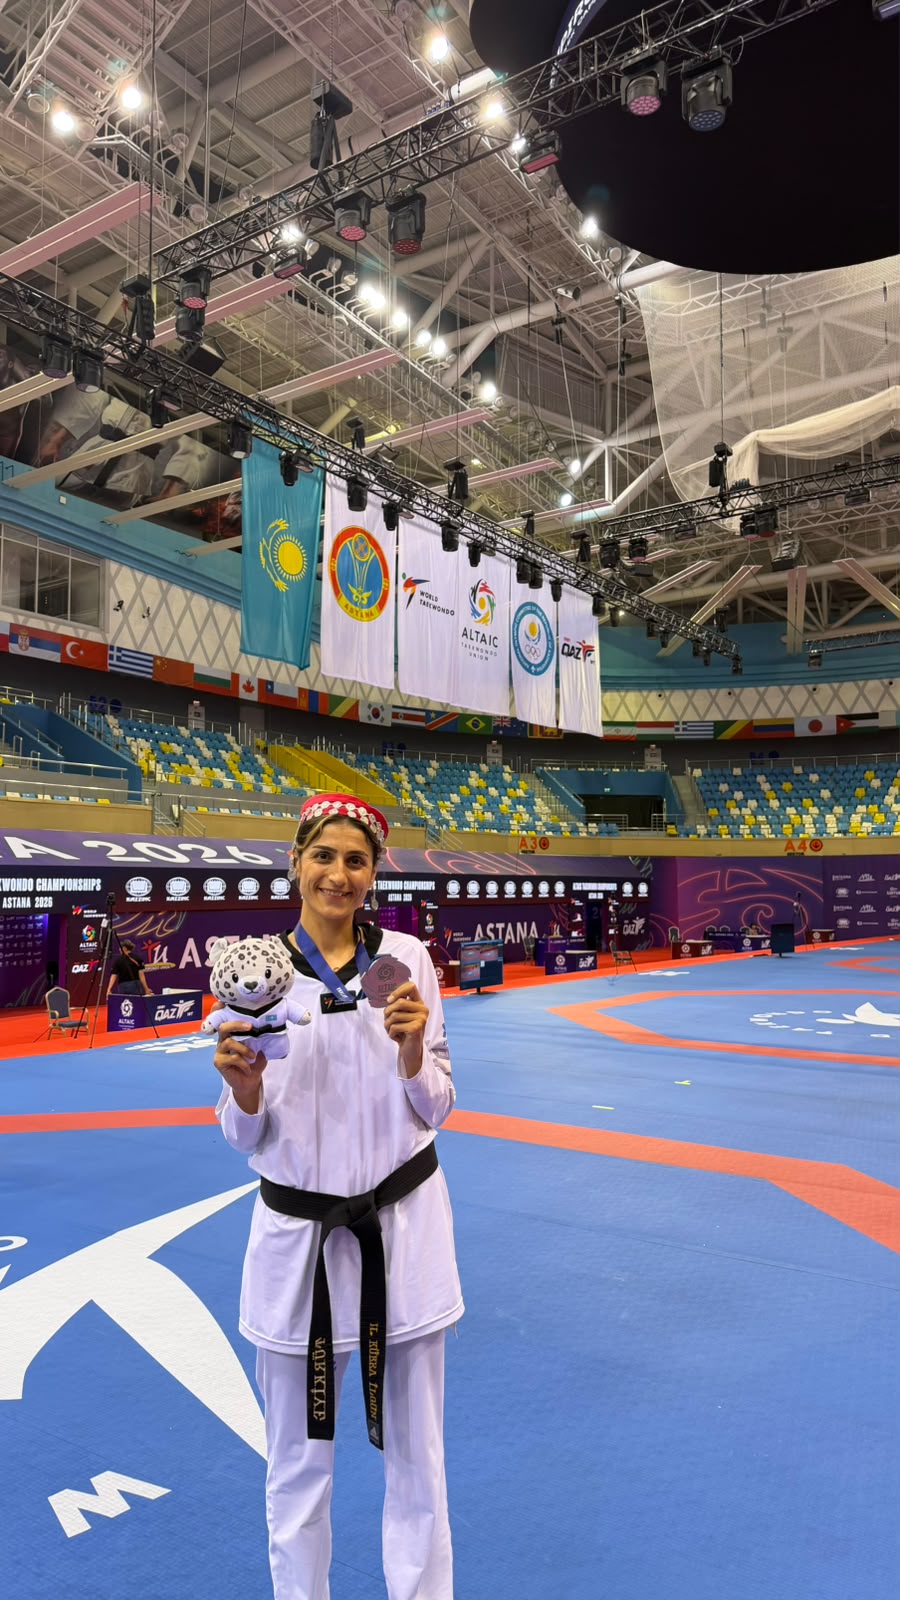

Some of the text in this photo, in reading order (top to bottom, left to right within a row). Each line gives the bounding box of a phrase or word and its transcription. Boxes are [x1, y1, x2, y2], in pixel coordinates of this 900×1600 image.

[419, 590, 439, 603] WORLD
[419, 599, 455, 616] TAEKWONDO
[461, 626, 498, 649] ALTAIC
[461, 641, 498, 657] TAEKWONDO
[469, 651, 489, 661] UNION
[519, 836, 538, 850] A3
[784, 839, 808, 852] A4
[82, 840, 273, 865] 2026
[36, 878, 101, 891] CHAMPIONSHIPS
[2, 896, 53, 908] ASTANA 2026
[474, 921, 539, 945] ASTANA
[118, 1018, 135, 1026] ALTAIC
